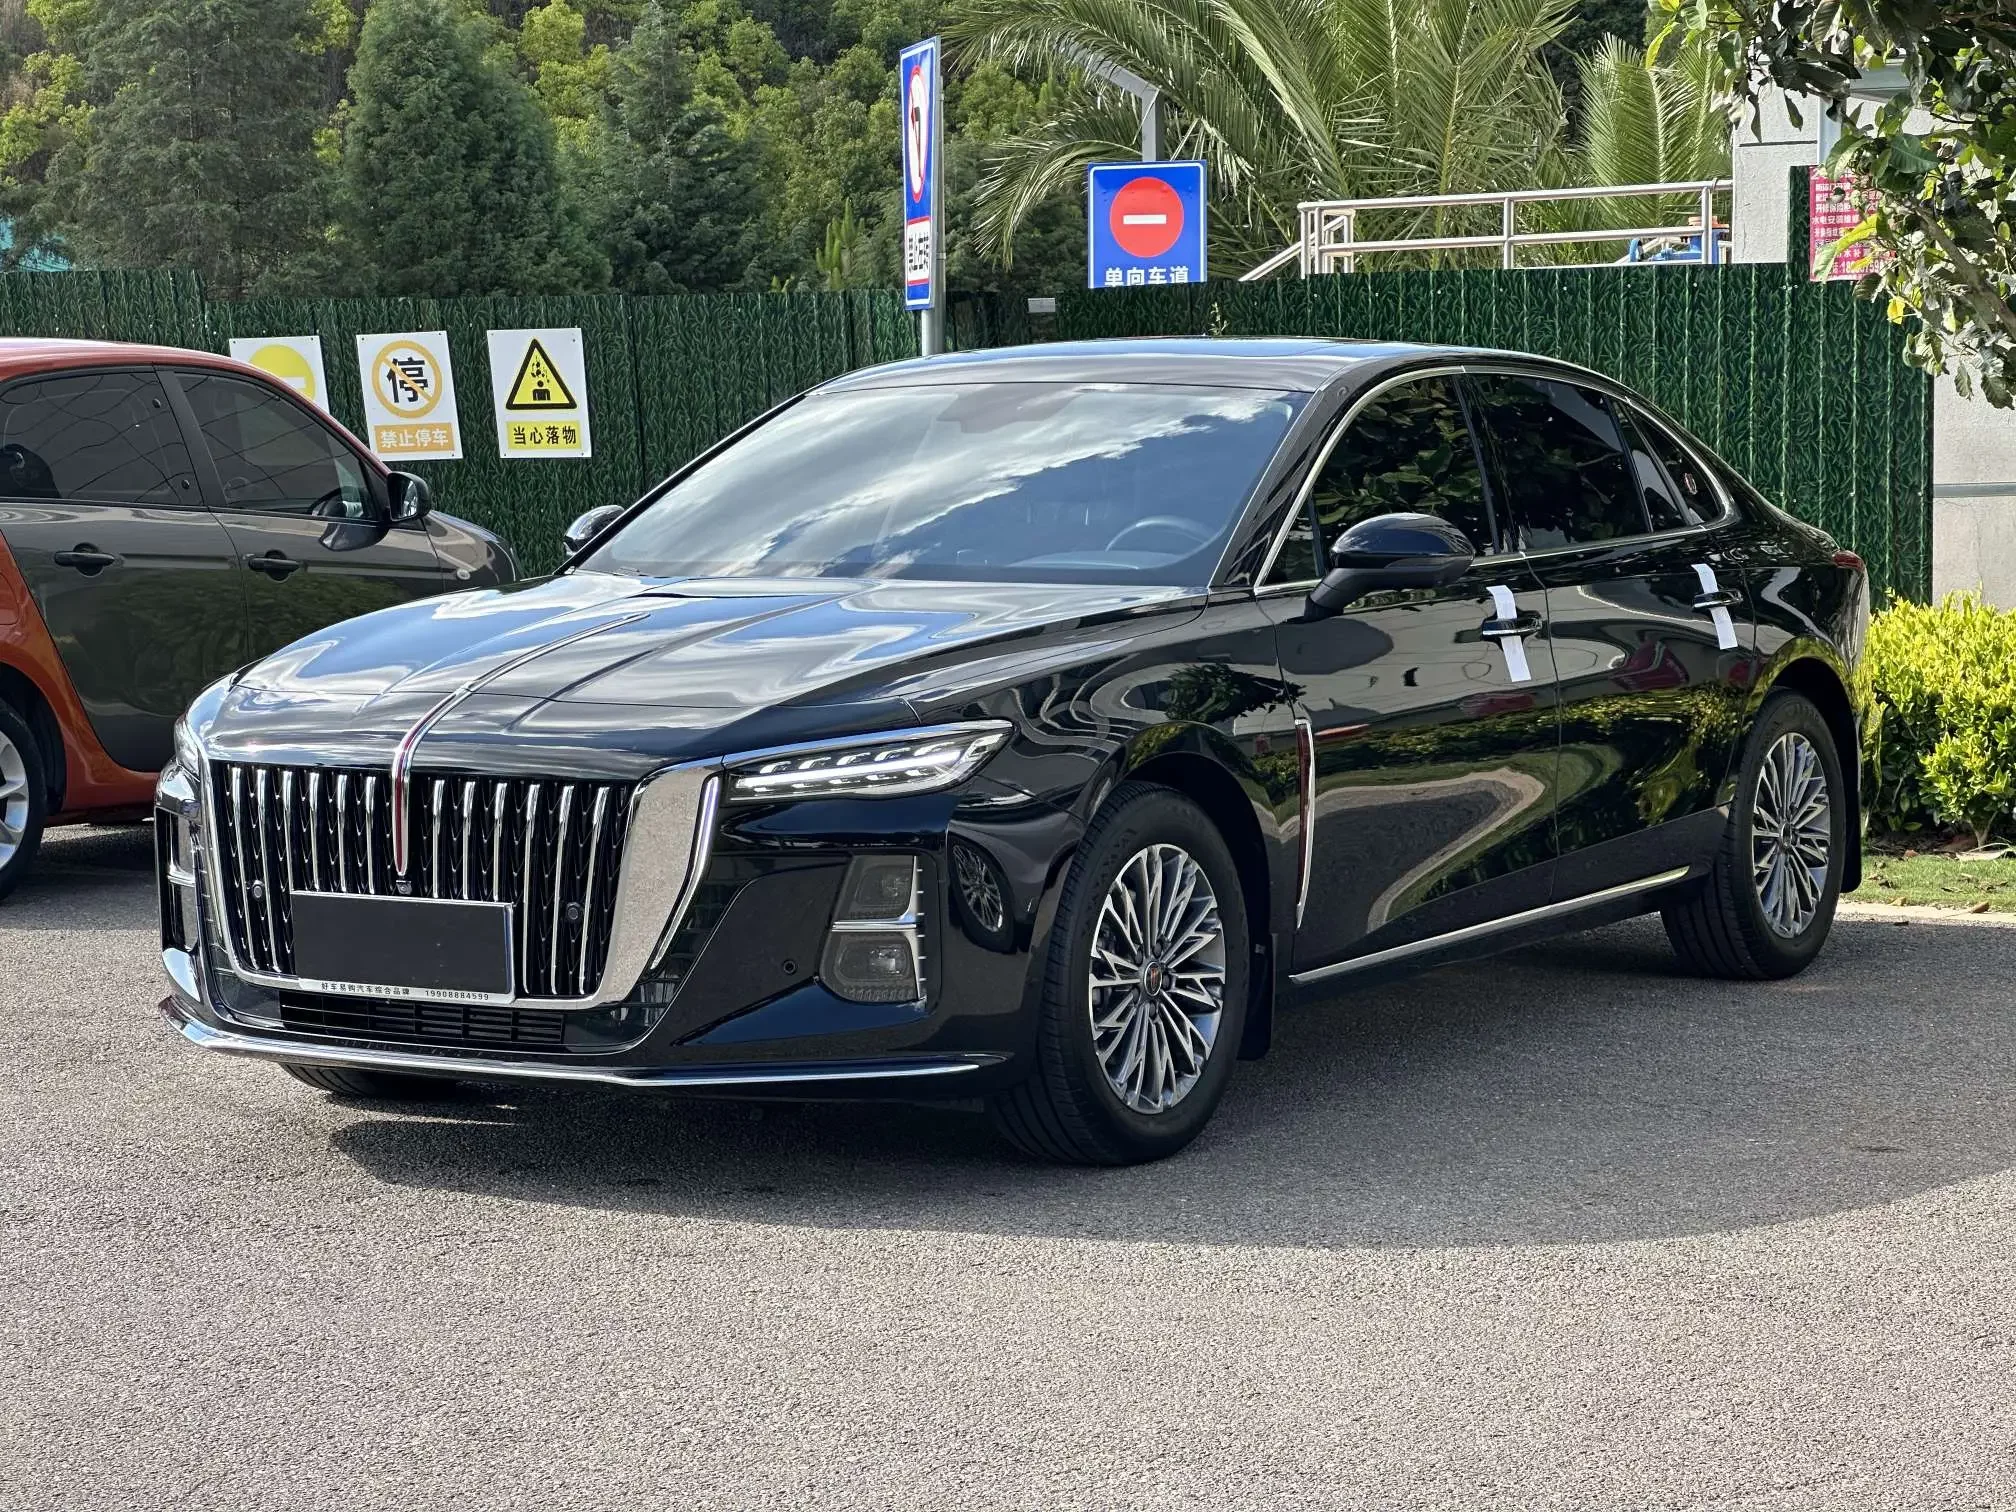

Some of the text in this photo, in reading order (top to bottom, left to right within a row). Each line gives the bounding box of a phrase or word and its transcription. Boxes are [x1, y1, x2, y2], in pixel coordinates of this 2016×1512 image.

[1104, 265, 1189, 287] 单向车道
[386, 357, 429, 403] 停
[380, 427, 449, 449] 禁止停车
[513, 425, 577, 445] 当心落物
[425, 989, 489, 1000] 19908884599
